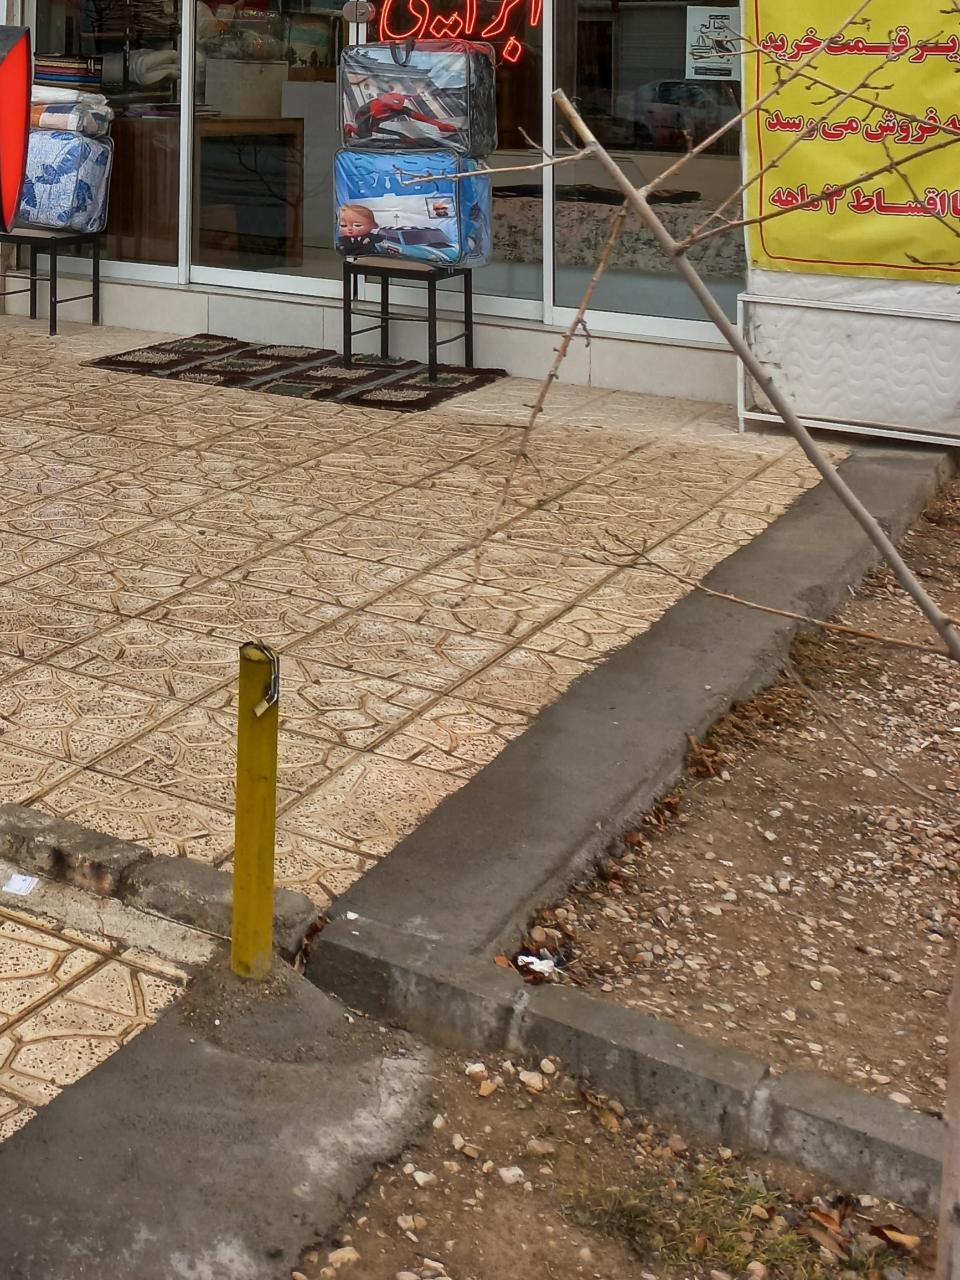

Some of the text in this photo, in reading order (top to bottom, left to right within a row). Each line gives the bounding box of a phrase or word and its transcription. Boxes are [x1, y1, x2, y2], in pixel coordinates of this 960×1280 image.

[760, 27, 824, 61] خرید
[824, 26, 910, 60] قیمت
[909, 34, 960, 63] یر
[863, 108, 941, 144] فروش
[848, 187, 947, 218] اقساط
